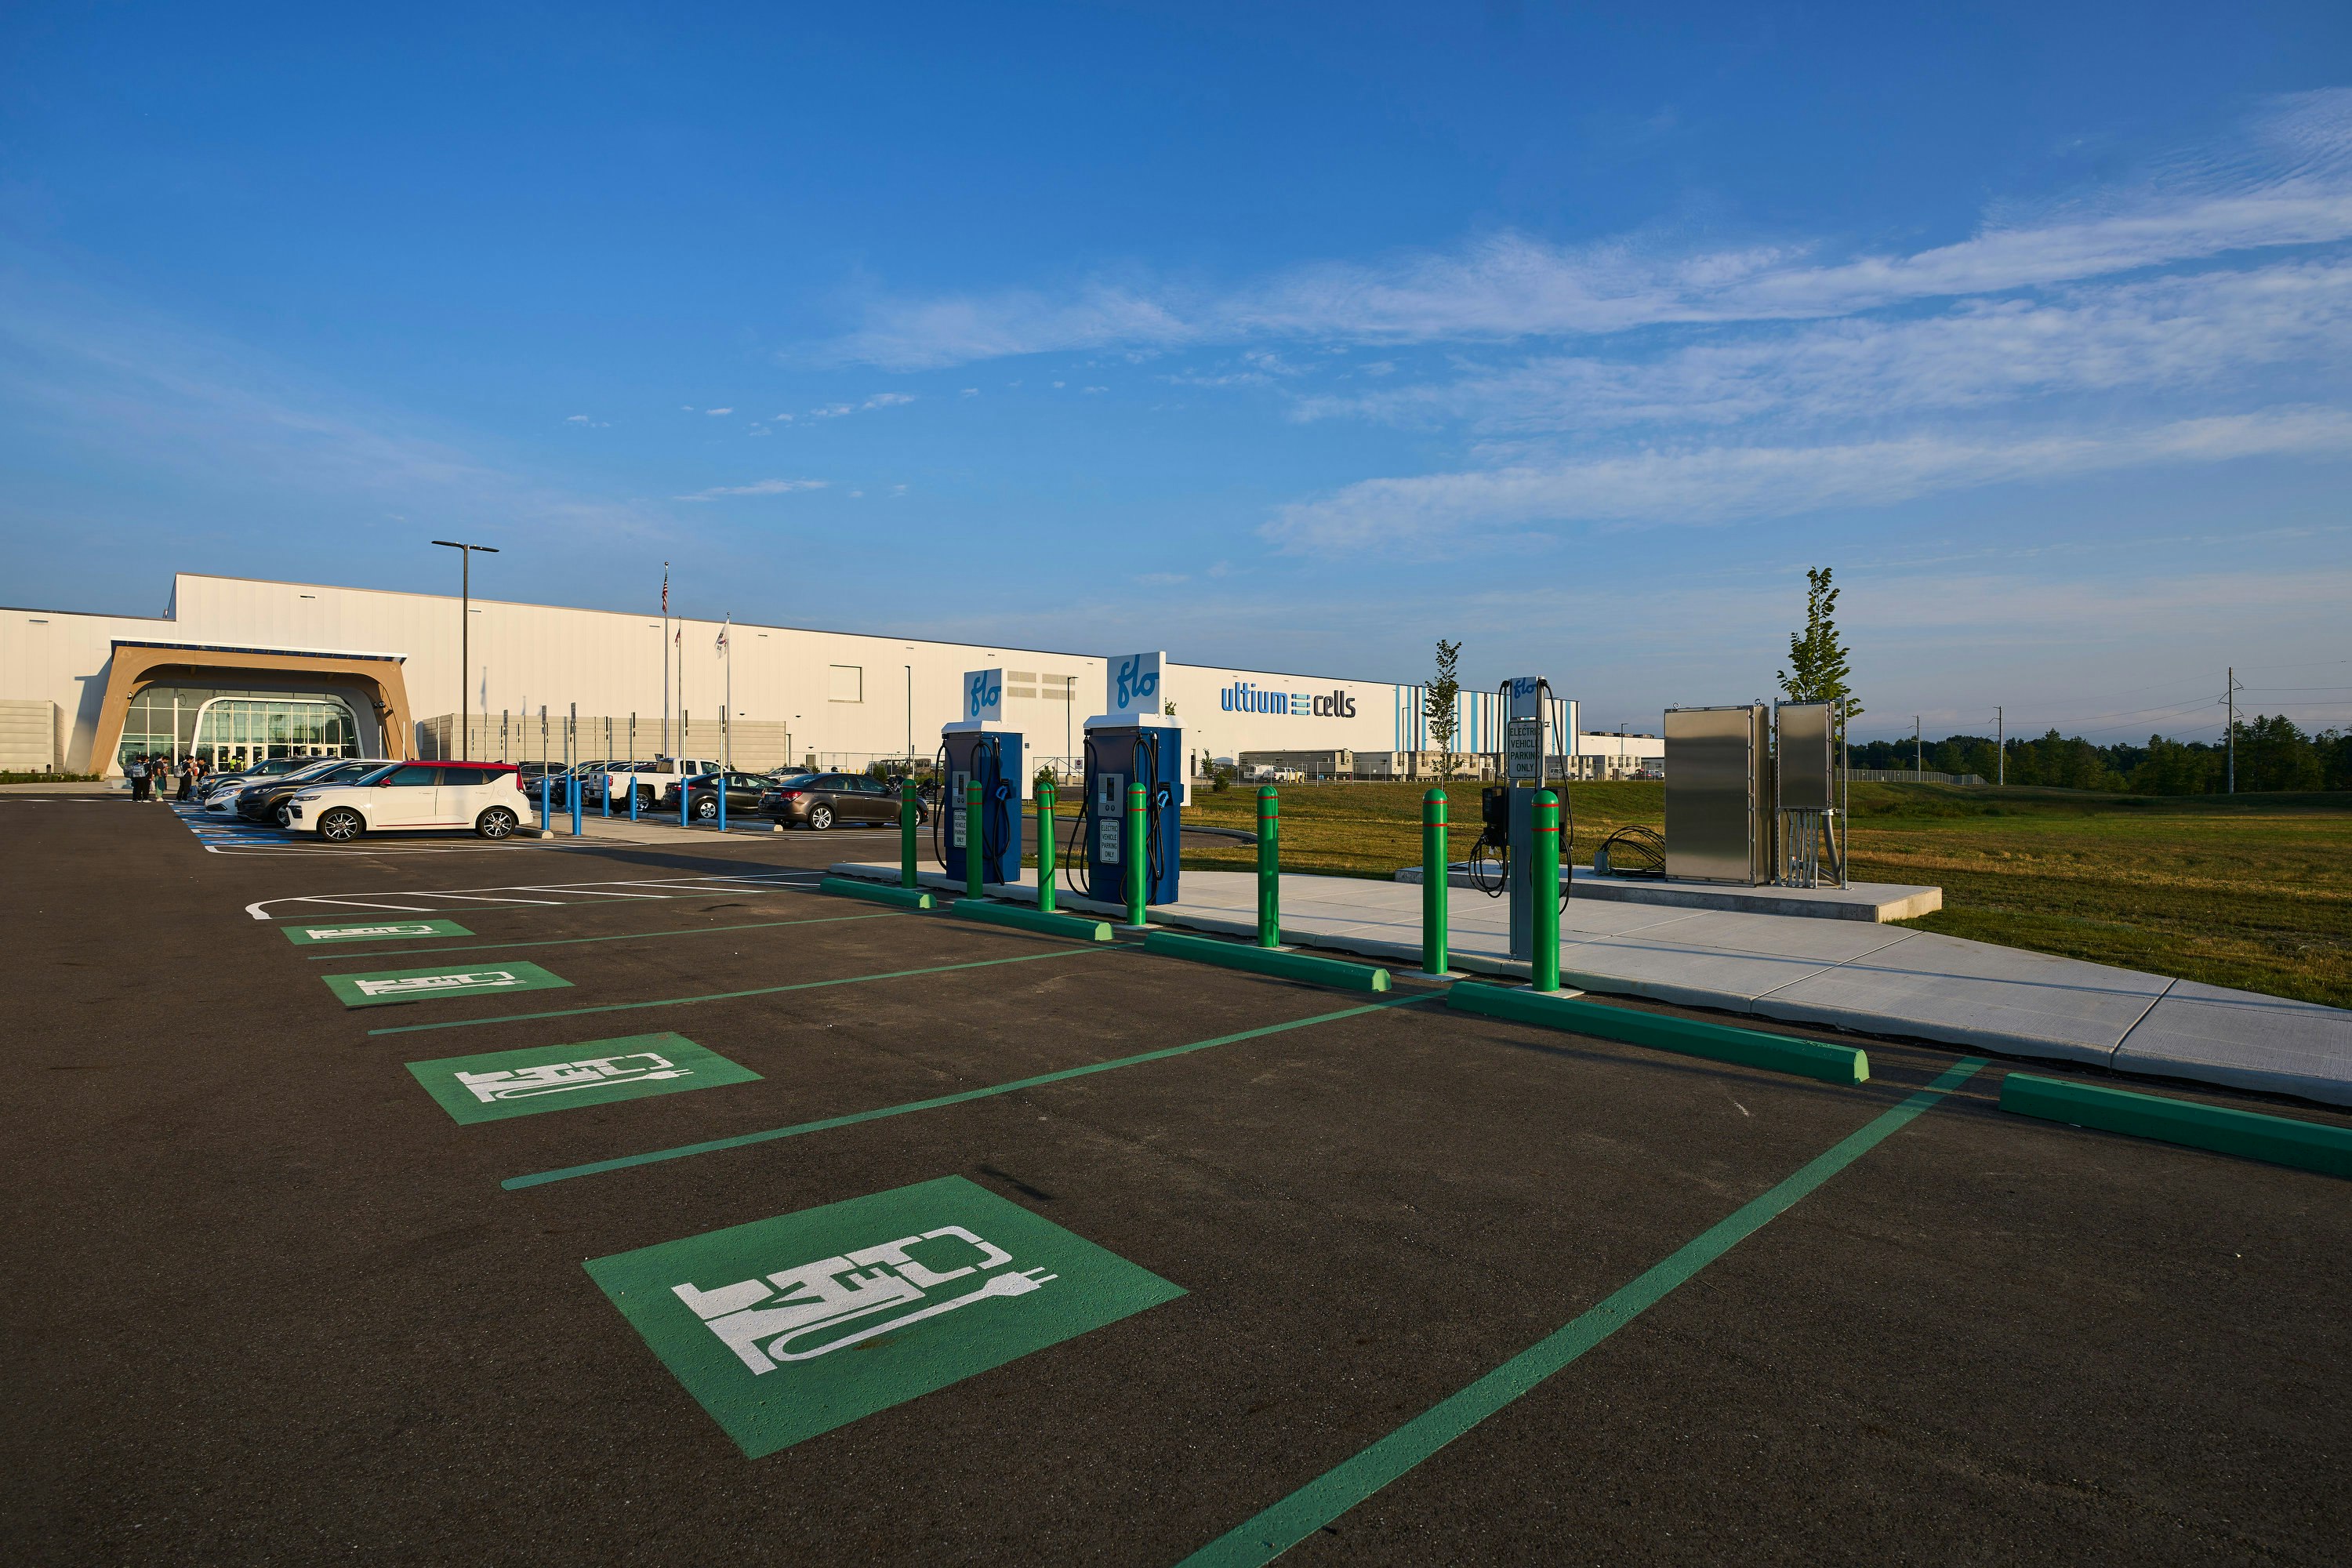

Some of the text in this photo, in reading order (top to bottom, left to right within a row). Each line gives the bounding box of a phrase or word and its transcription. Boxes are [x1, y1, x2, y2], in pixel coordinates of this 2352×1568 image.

[971, 670, 1001, 717] flo
[1116, 654, 1160, 709] flo
[1513, 677, 1537, 699] flo
[1221, 682, 1356, 718] ultium cells
[1511, 739, 1540, 748] VEHICL
[1516, 764, 1534, 772] ONLY
